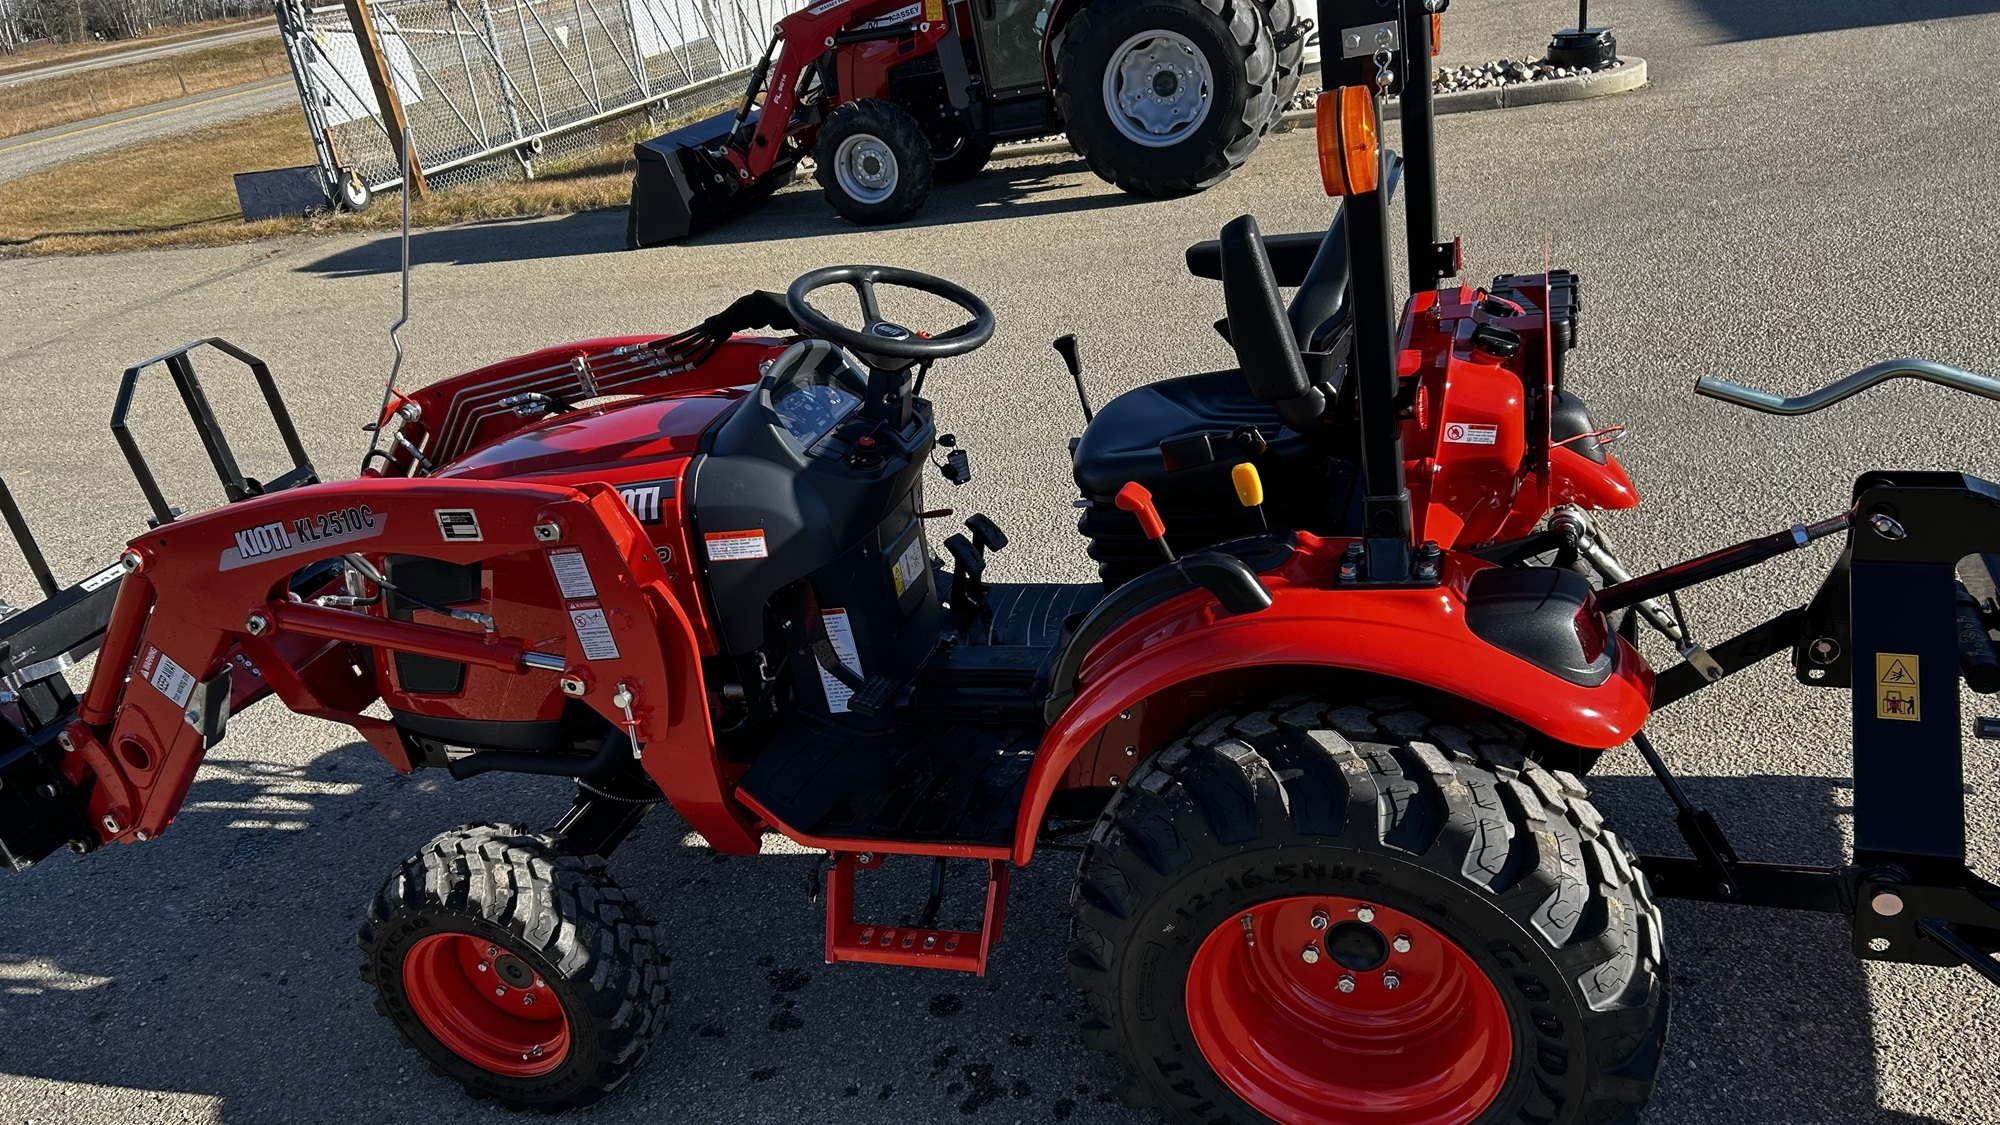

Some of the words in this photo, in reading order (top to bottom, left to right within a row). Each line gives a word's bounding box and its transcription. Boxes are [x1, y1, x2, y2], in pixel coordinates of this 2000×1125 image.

[819, 1, 838, 11] MASSEY
[617, 486, 661, 520] OTI
[234, 521, 292, 559] KIOTI
[294, 505, 375, 544] KL2510C
[142, 646, 158, 671] WARNING
[162, 658, 176, 680] AWAY
[157, 675, 170, 693] KEEP
[378, 917, 430, 1023] GOODYEAR
